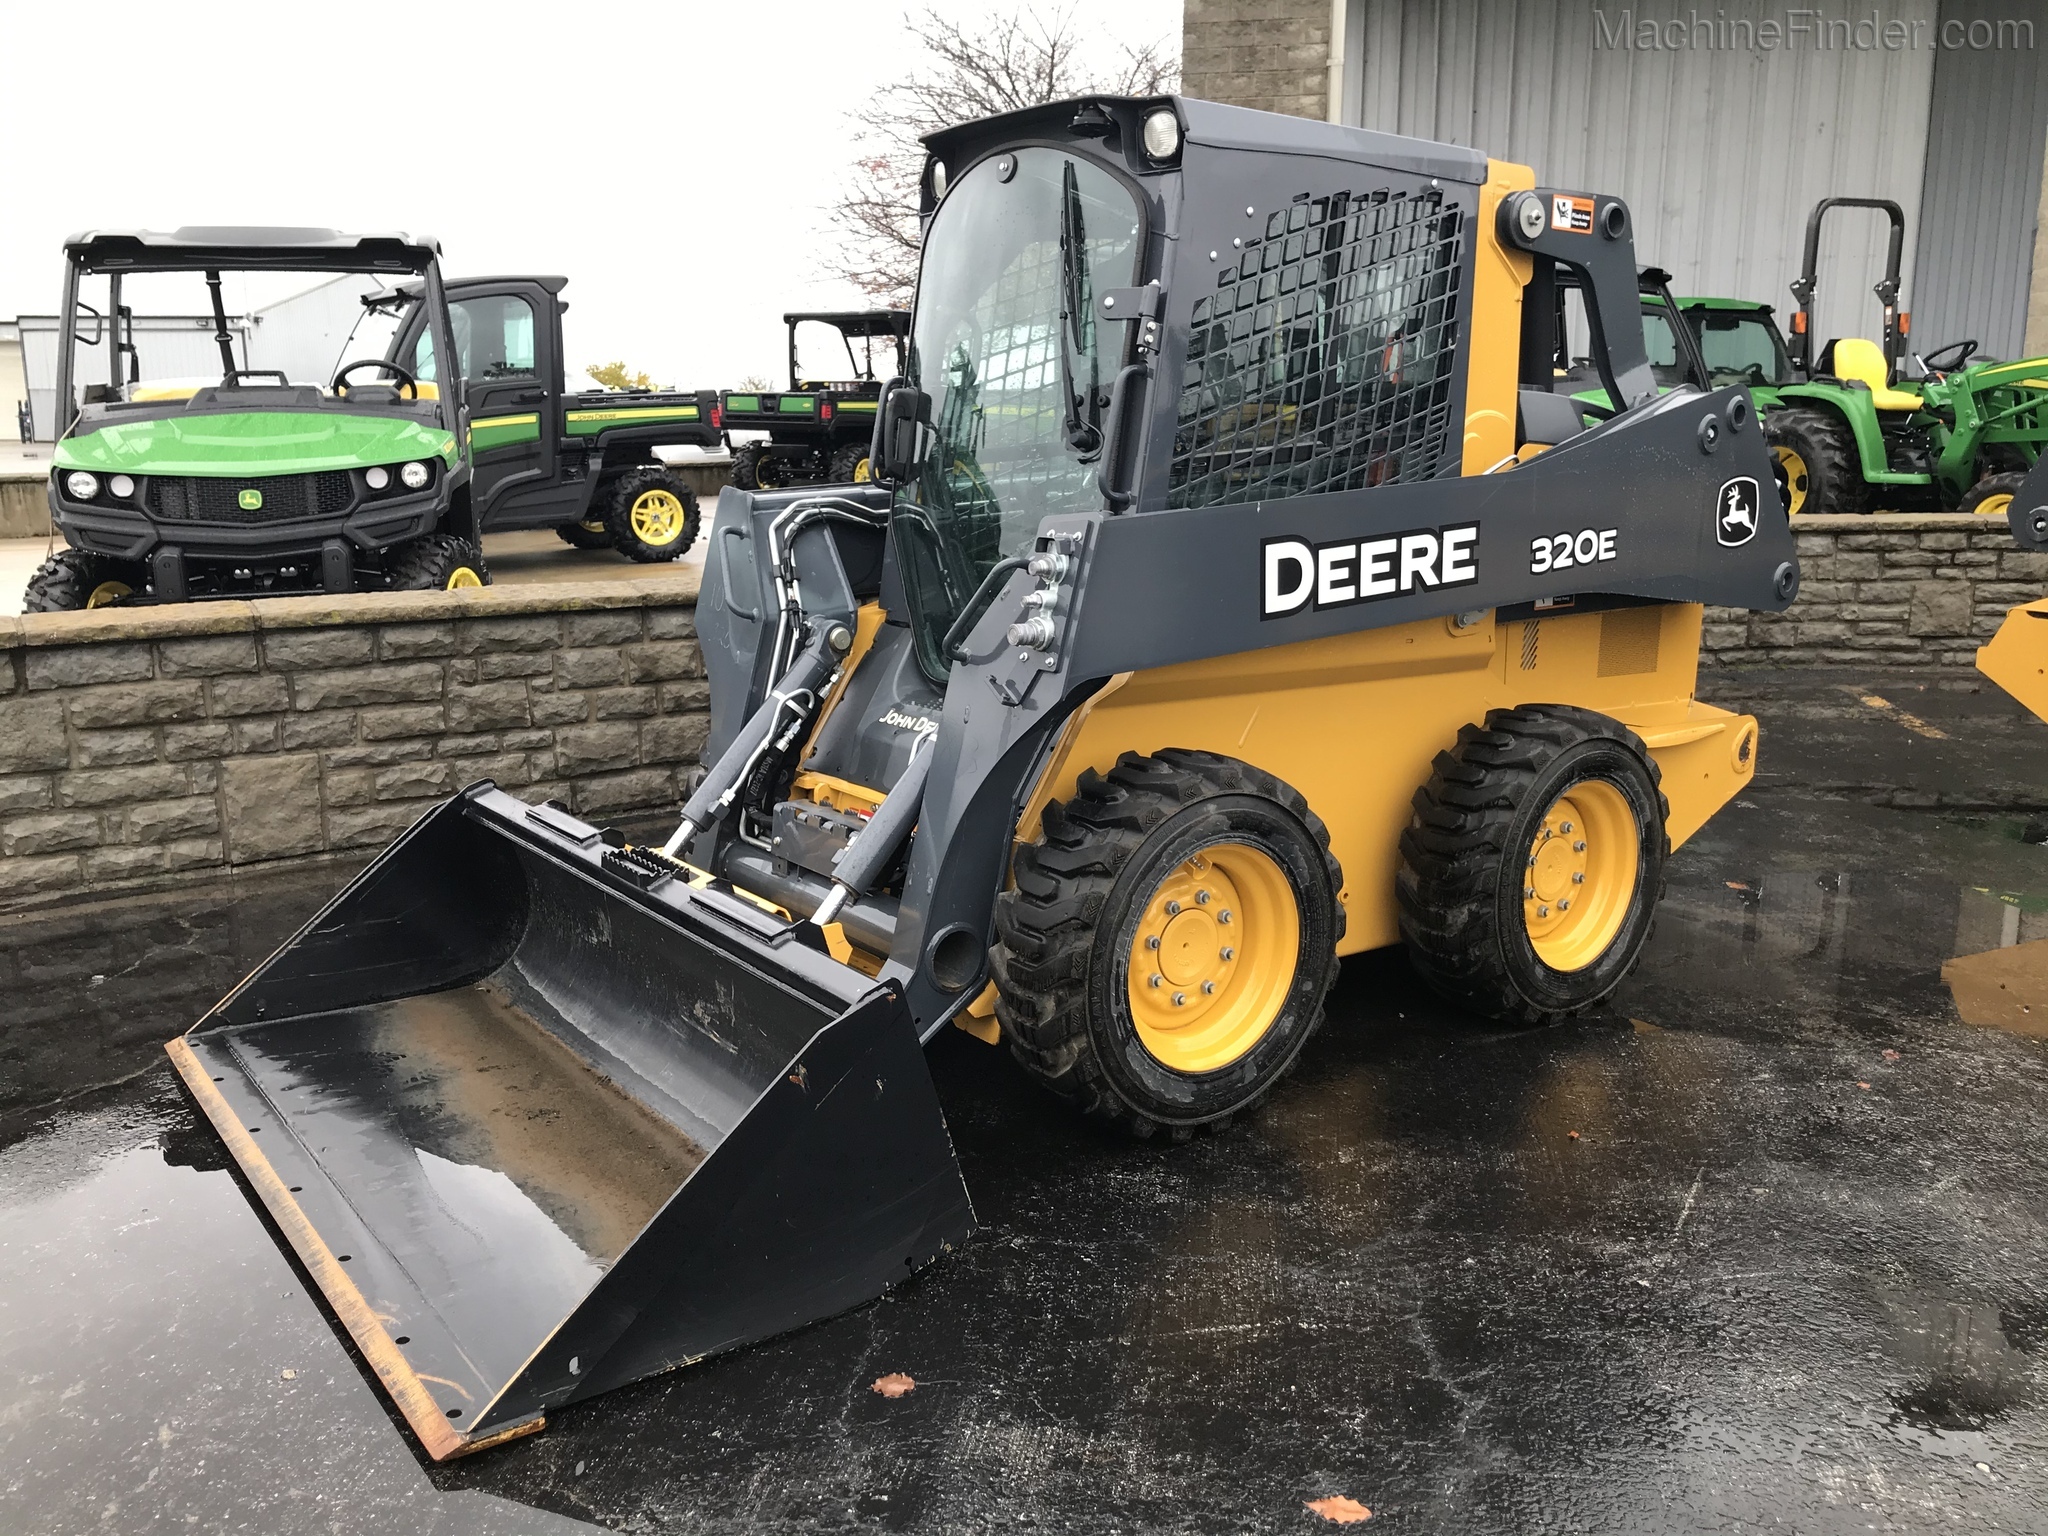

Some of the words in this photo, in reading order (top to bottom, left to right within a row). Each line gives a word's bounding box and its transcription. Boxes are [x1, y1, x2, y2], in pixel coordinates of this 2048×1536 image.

[1265, 526, 1477, 614] DEERE
[1531, 528, 1618, 574] 320E
[879, 708, 917, 730] JOHN
